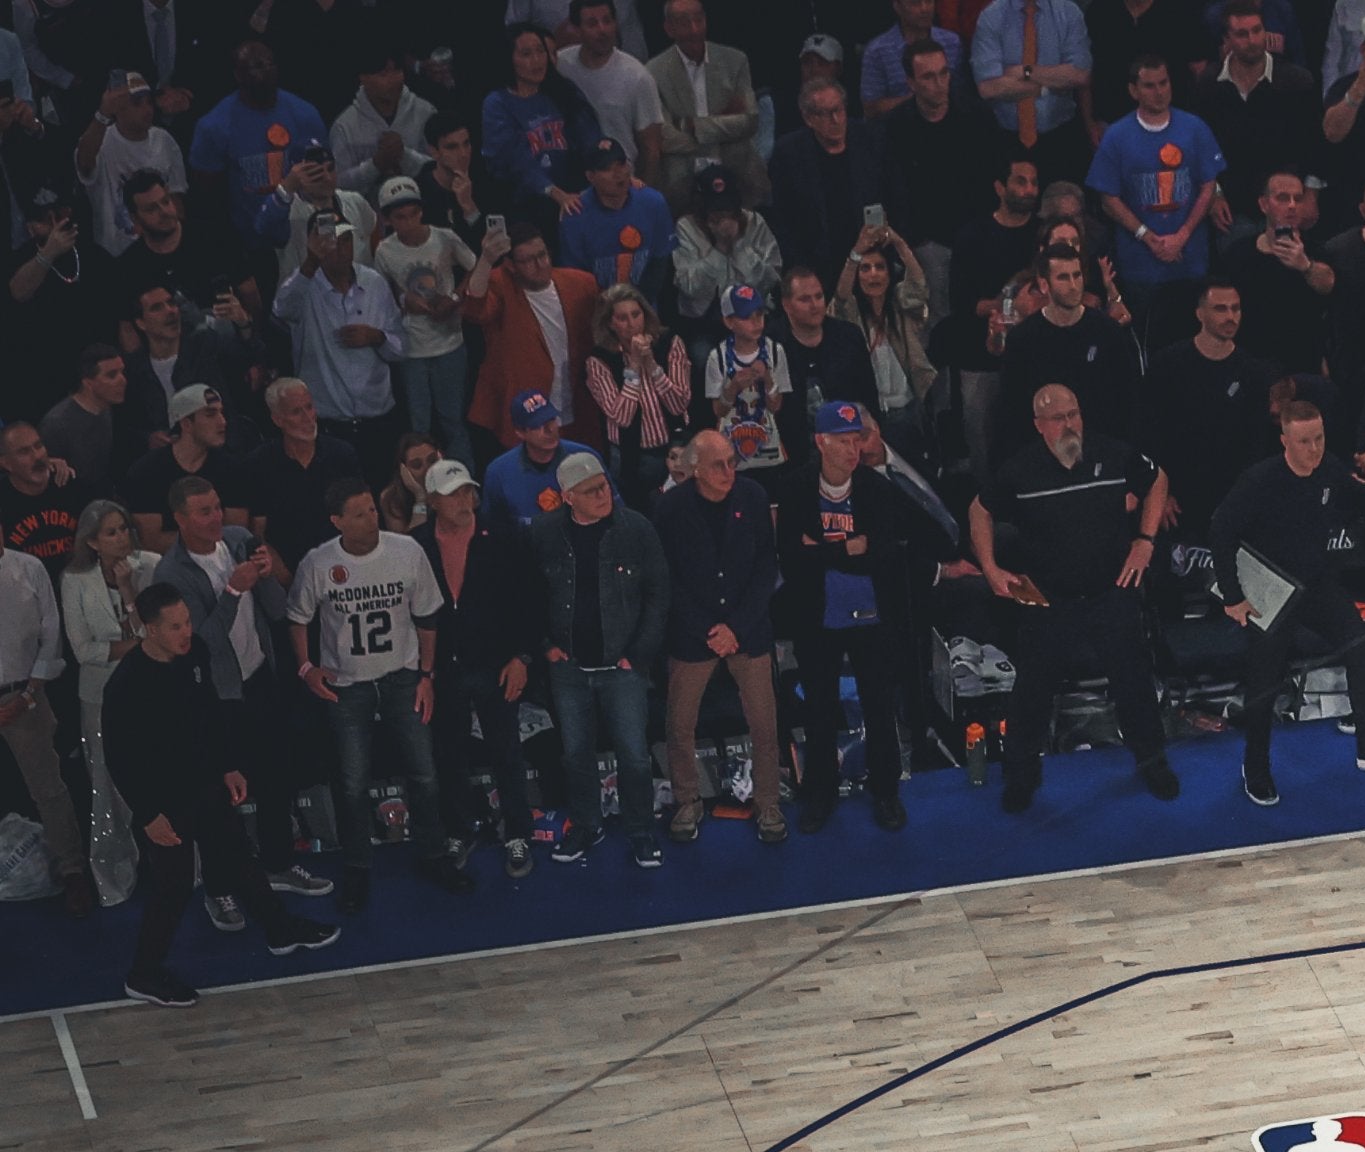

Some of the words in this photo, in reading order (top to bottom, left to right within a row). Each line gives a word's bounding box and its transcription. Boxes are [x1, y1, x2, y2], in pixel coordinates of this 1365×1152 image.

[9, 514, 40, 546] NEW
[328, 581, 404, 602] McDONALD'S
[334, 603, 351, 614] ALL
[356, 595, 402, 612] AMERICAN
[348, 610, 393, 656] 12
